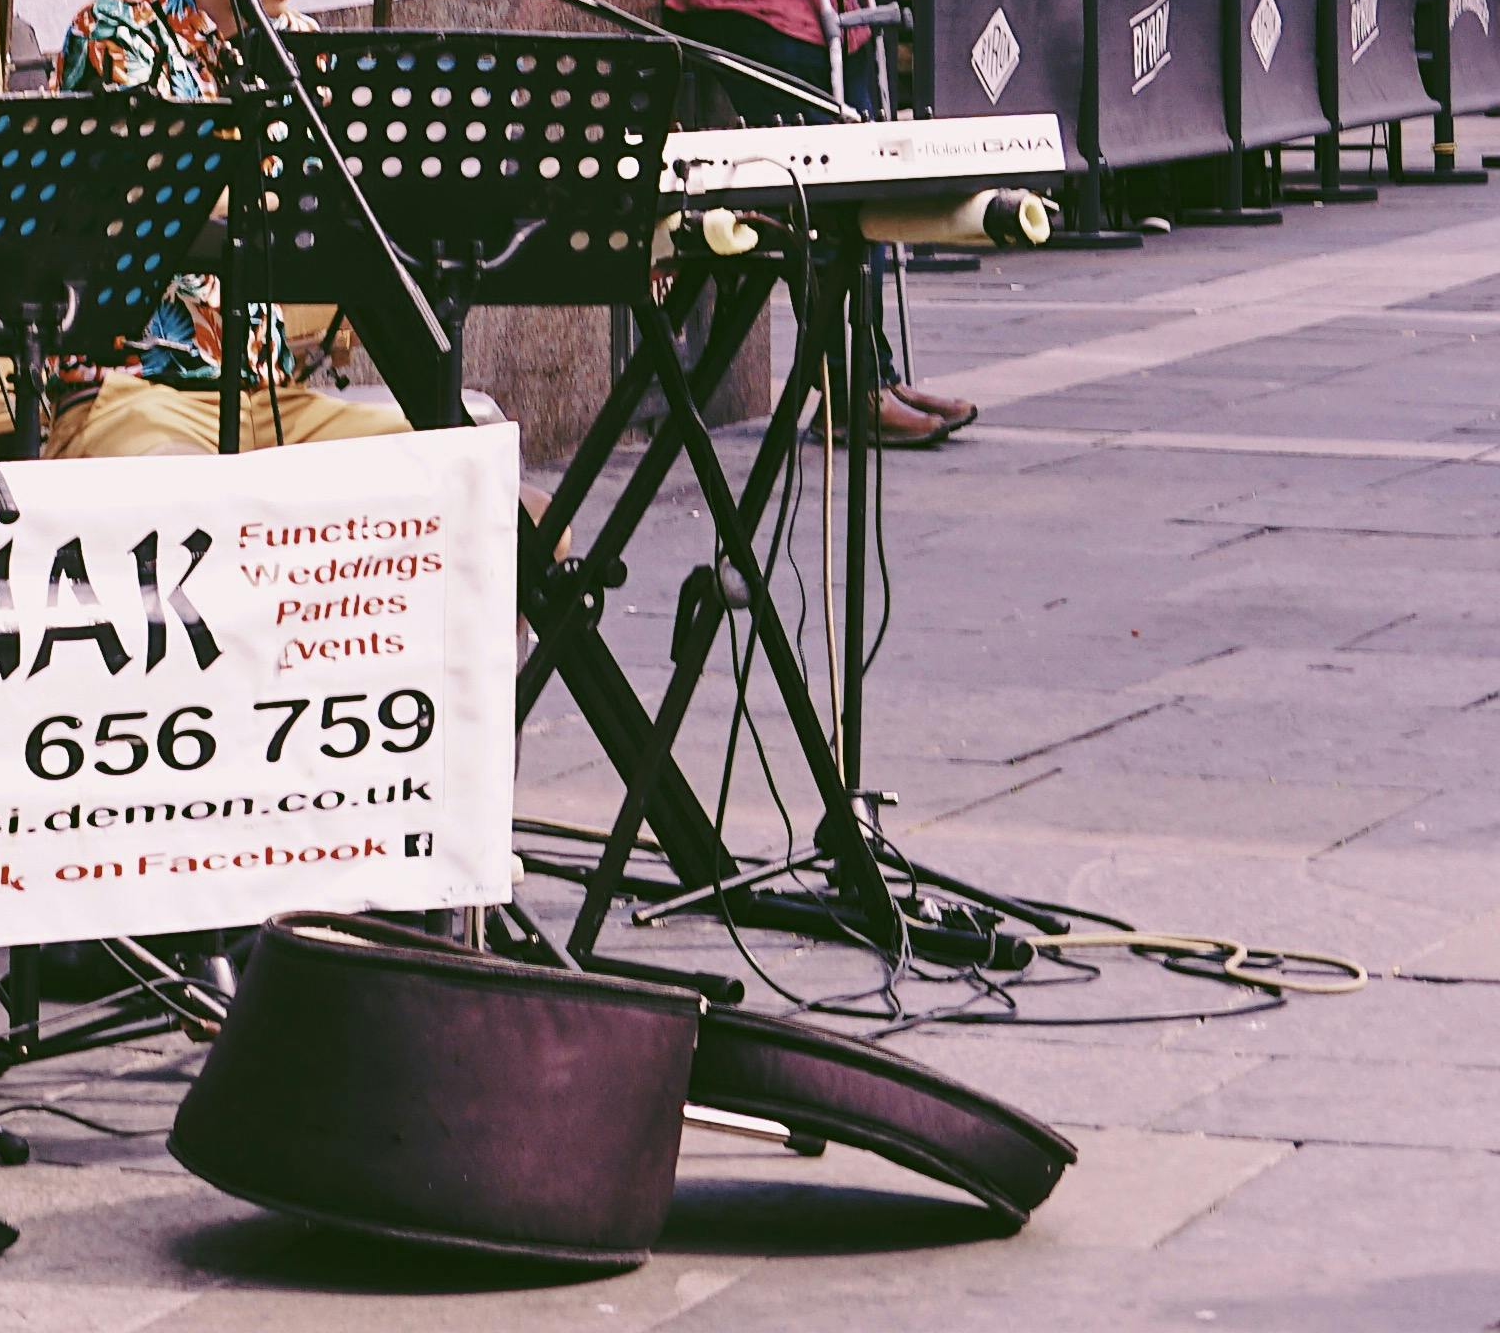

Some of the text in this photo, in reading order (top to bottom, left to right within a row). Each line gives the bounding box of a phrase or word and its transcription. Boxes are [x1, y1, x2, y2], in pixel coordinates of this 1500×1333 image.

[1133, 1, 1171, 80] BYRON
[925, 137, 1054, 158] Roland GAIA
[239, 515, 441, 549] Functions
[240, 551, 443, 589] Weddings
[276, 592, 408, 627] Parties
[25, 706, 217, 781] 656
[253, 689, 436, 764] 759
[56, 861, 123, 882] on
[138, 838, 387, 876] Facebook
